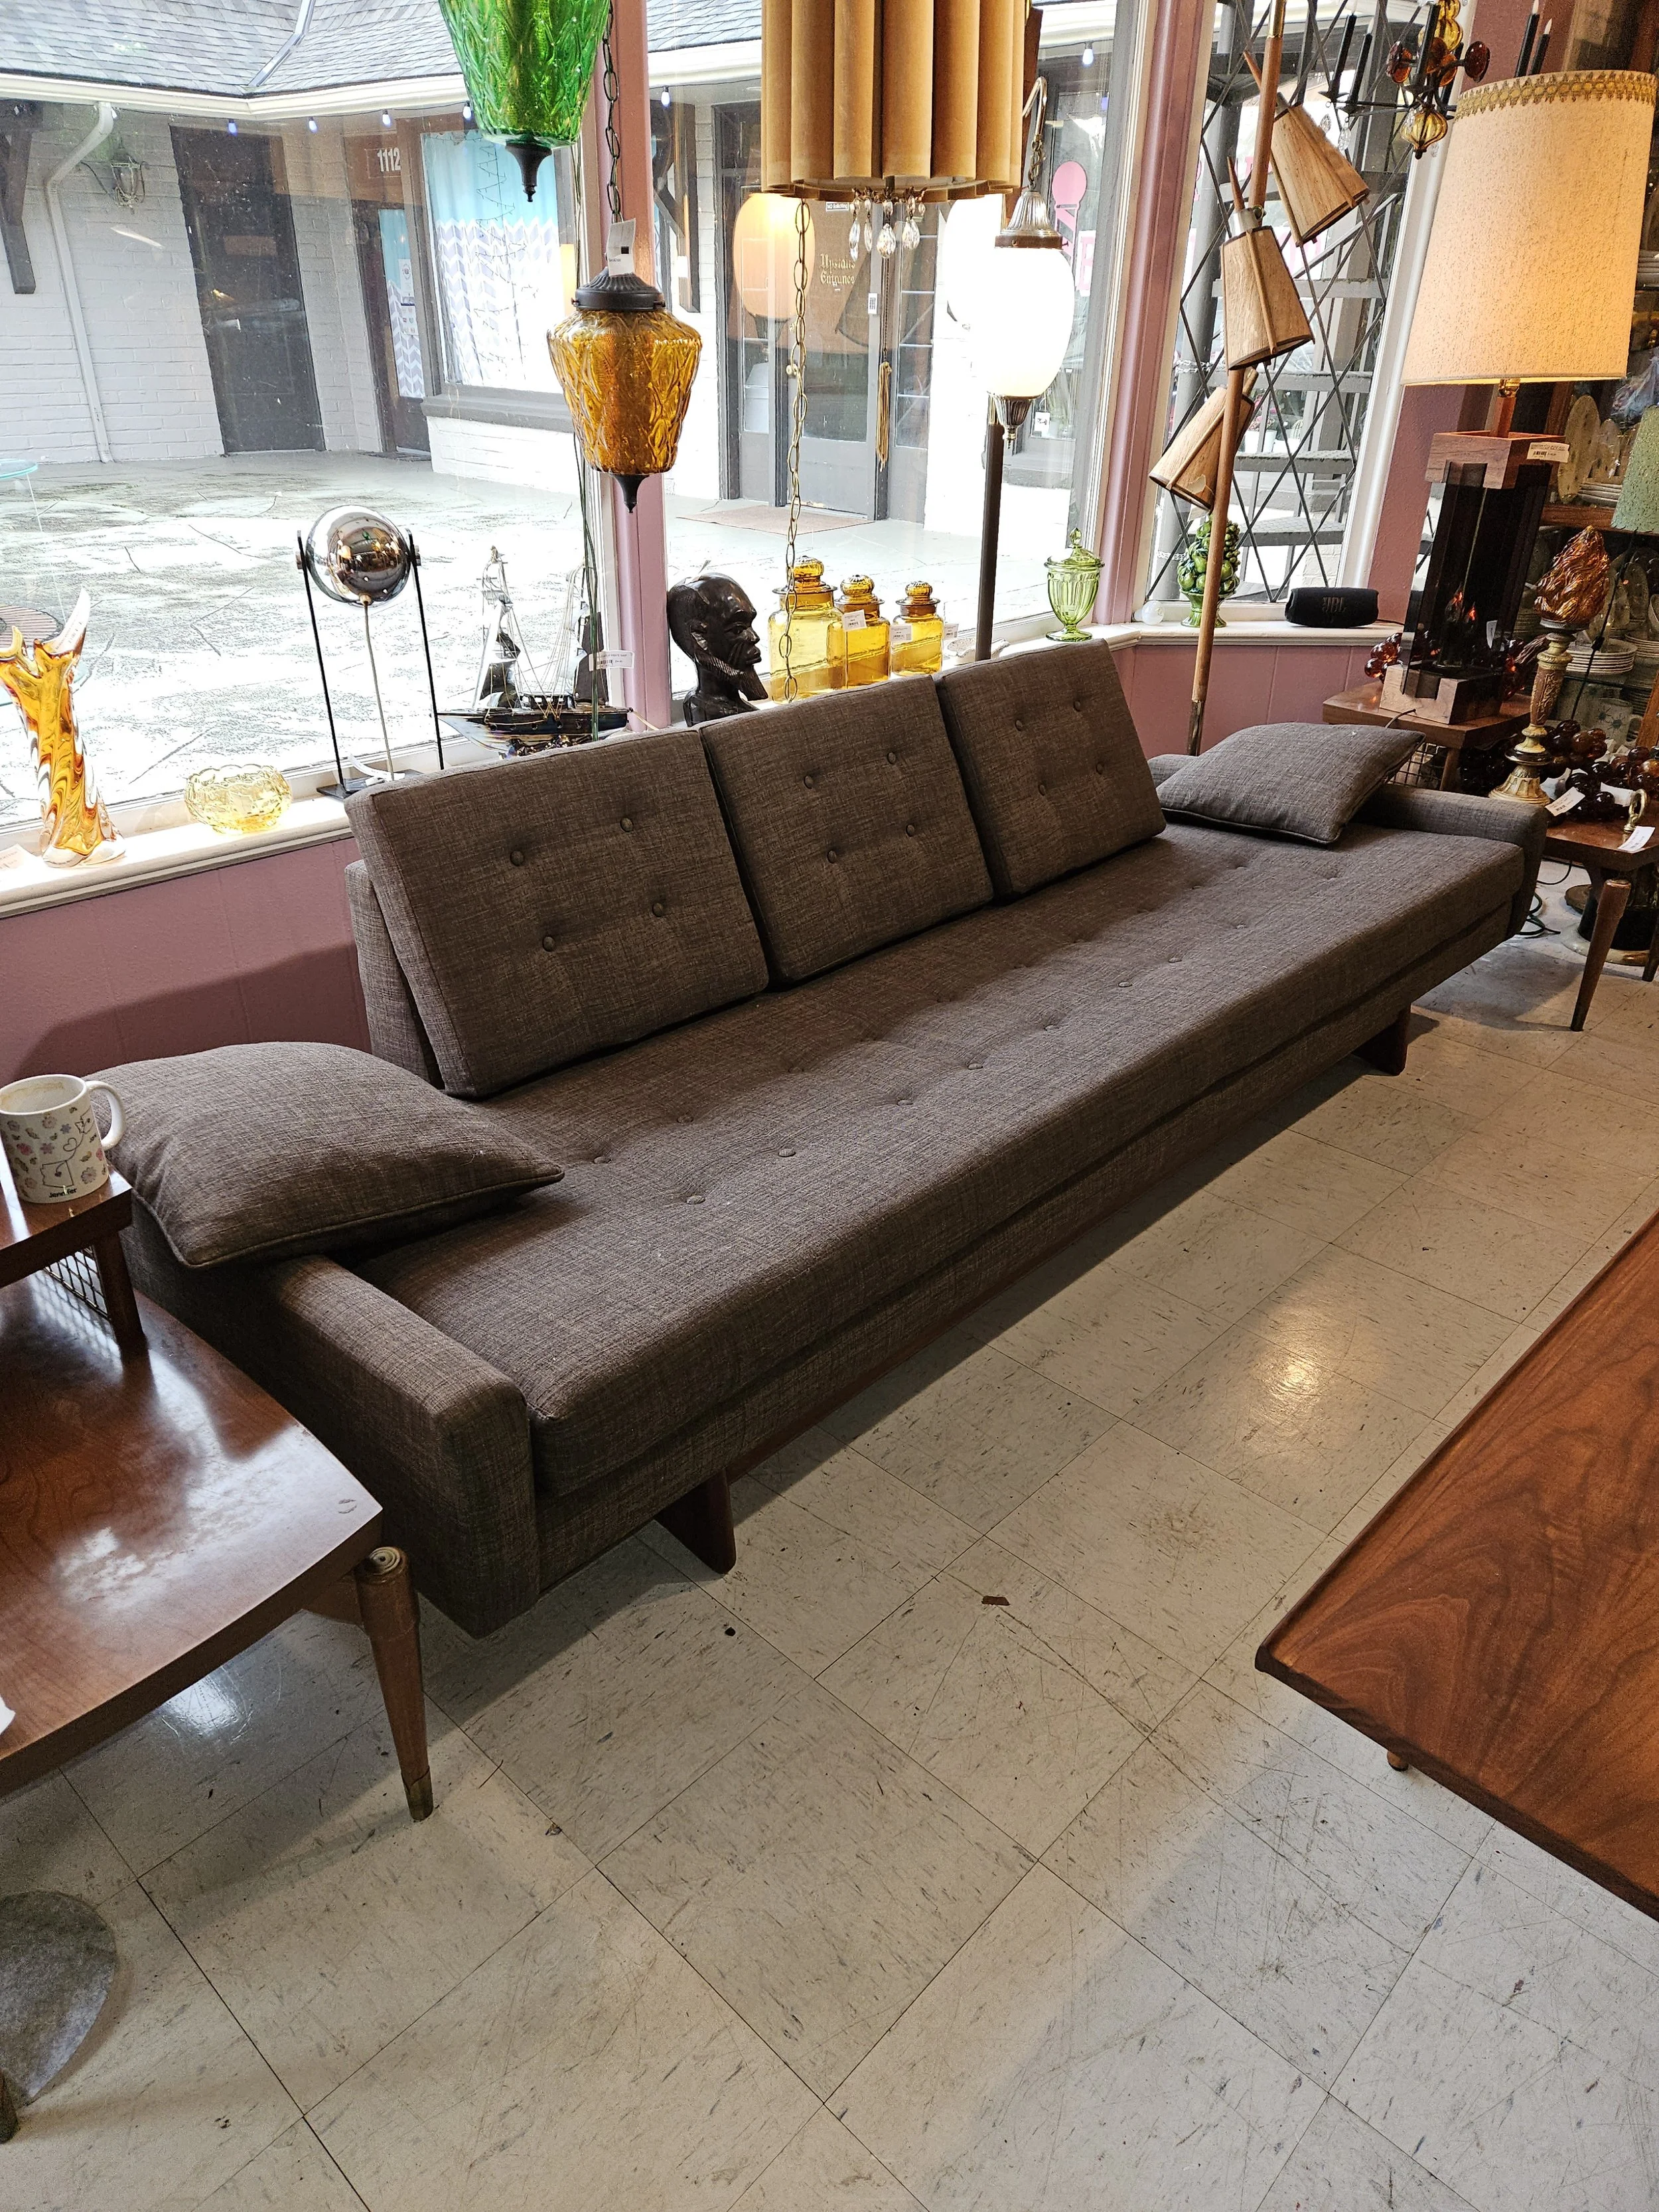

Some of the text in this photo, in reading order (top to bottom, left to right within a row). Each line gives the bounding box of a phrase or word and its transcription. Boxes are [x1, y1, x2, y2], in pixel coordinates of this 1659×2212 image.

[377, 147, 401, 172] 1112
[820, 270, 855, 285] Entrance
[1322, 597, 1347, 613] JBL
[48, 1188, 78, 1198] Jennfer
